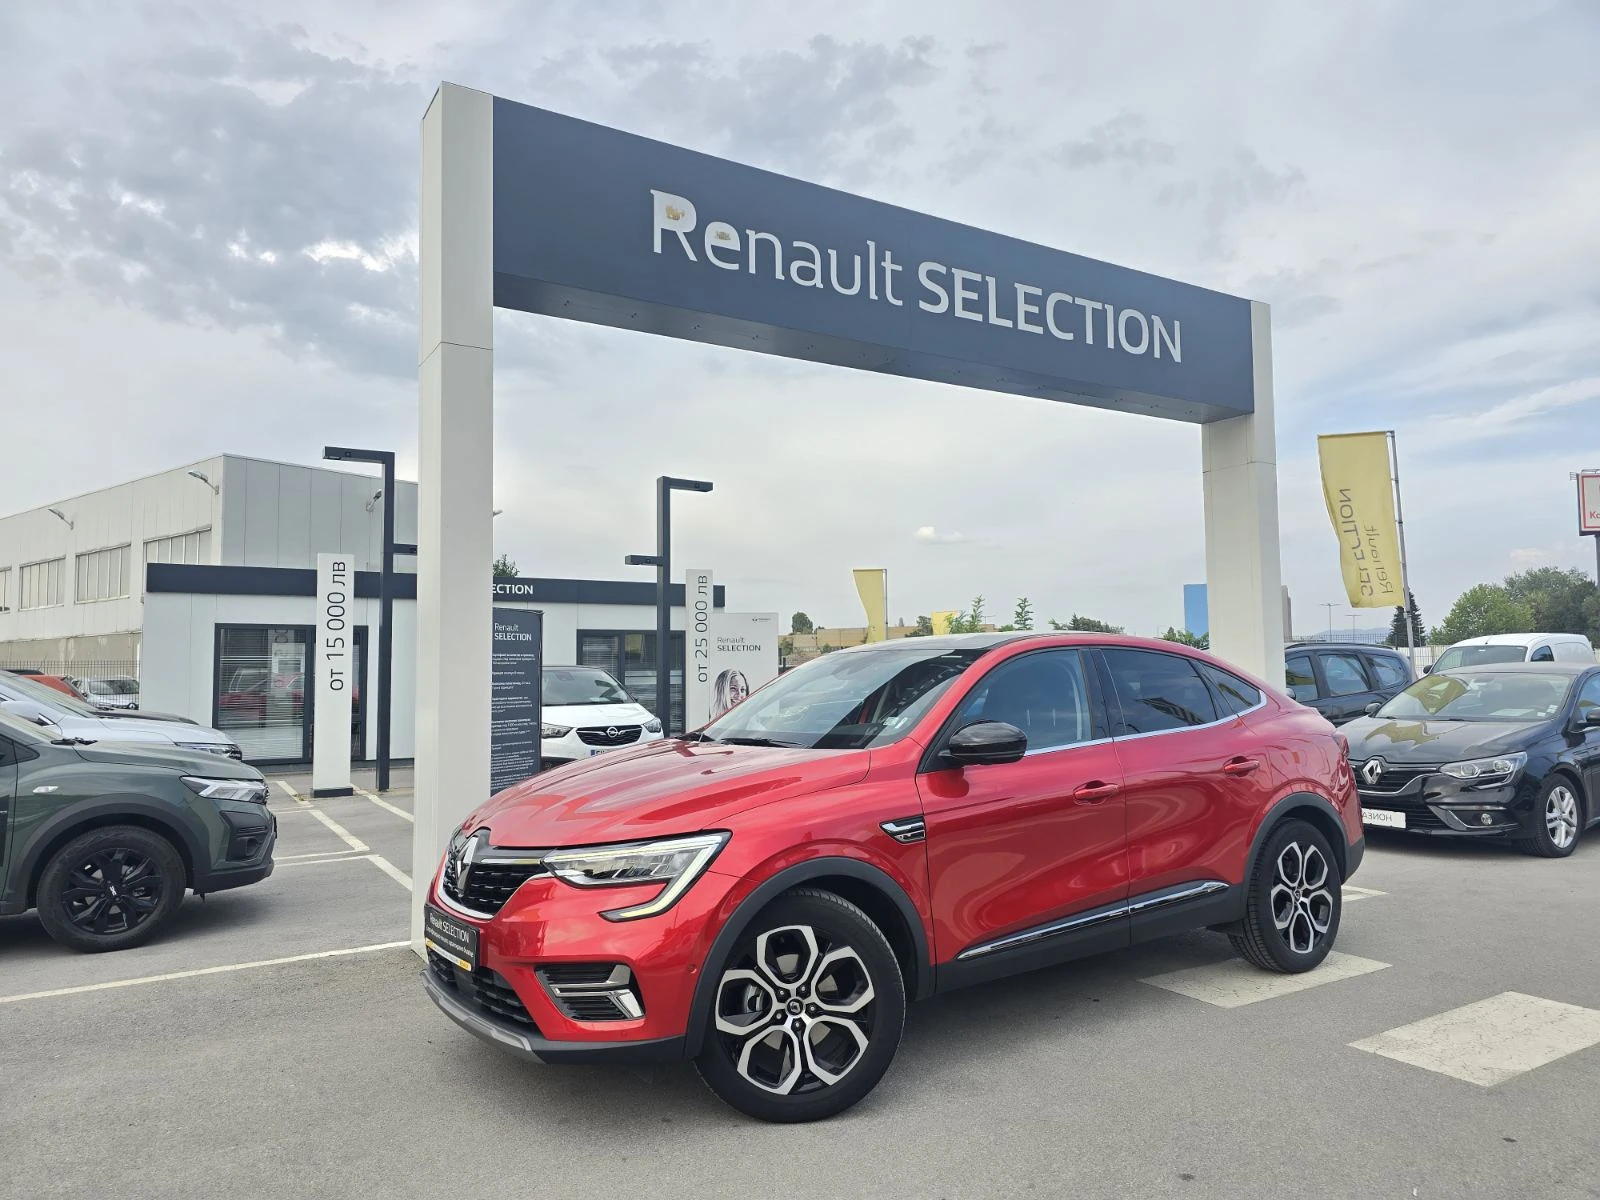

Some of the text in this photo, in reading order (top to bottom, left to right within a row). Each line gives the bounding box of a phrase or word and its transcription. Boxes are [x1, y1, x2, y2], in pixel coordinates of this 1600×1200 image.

[650, 189, 1182, 363] Renault SELECTION
[326, 592, 345, 631] 000
[695, 600, 708, 633] 000
[494, 622, 520, 632] Renault
[494, 632, 532, 641] SELECTION
[326, 637, 345, 661] 15
[695, 638, 708, 659] 25
[717, 636, 745, 644] Renault
[717, 644, 761, 652] SELECTION
[442, 921, 470, 943] SELECTION
